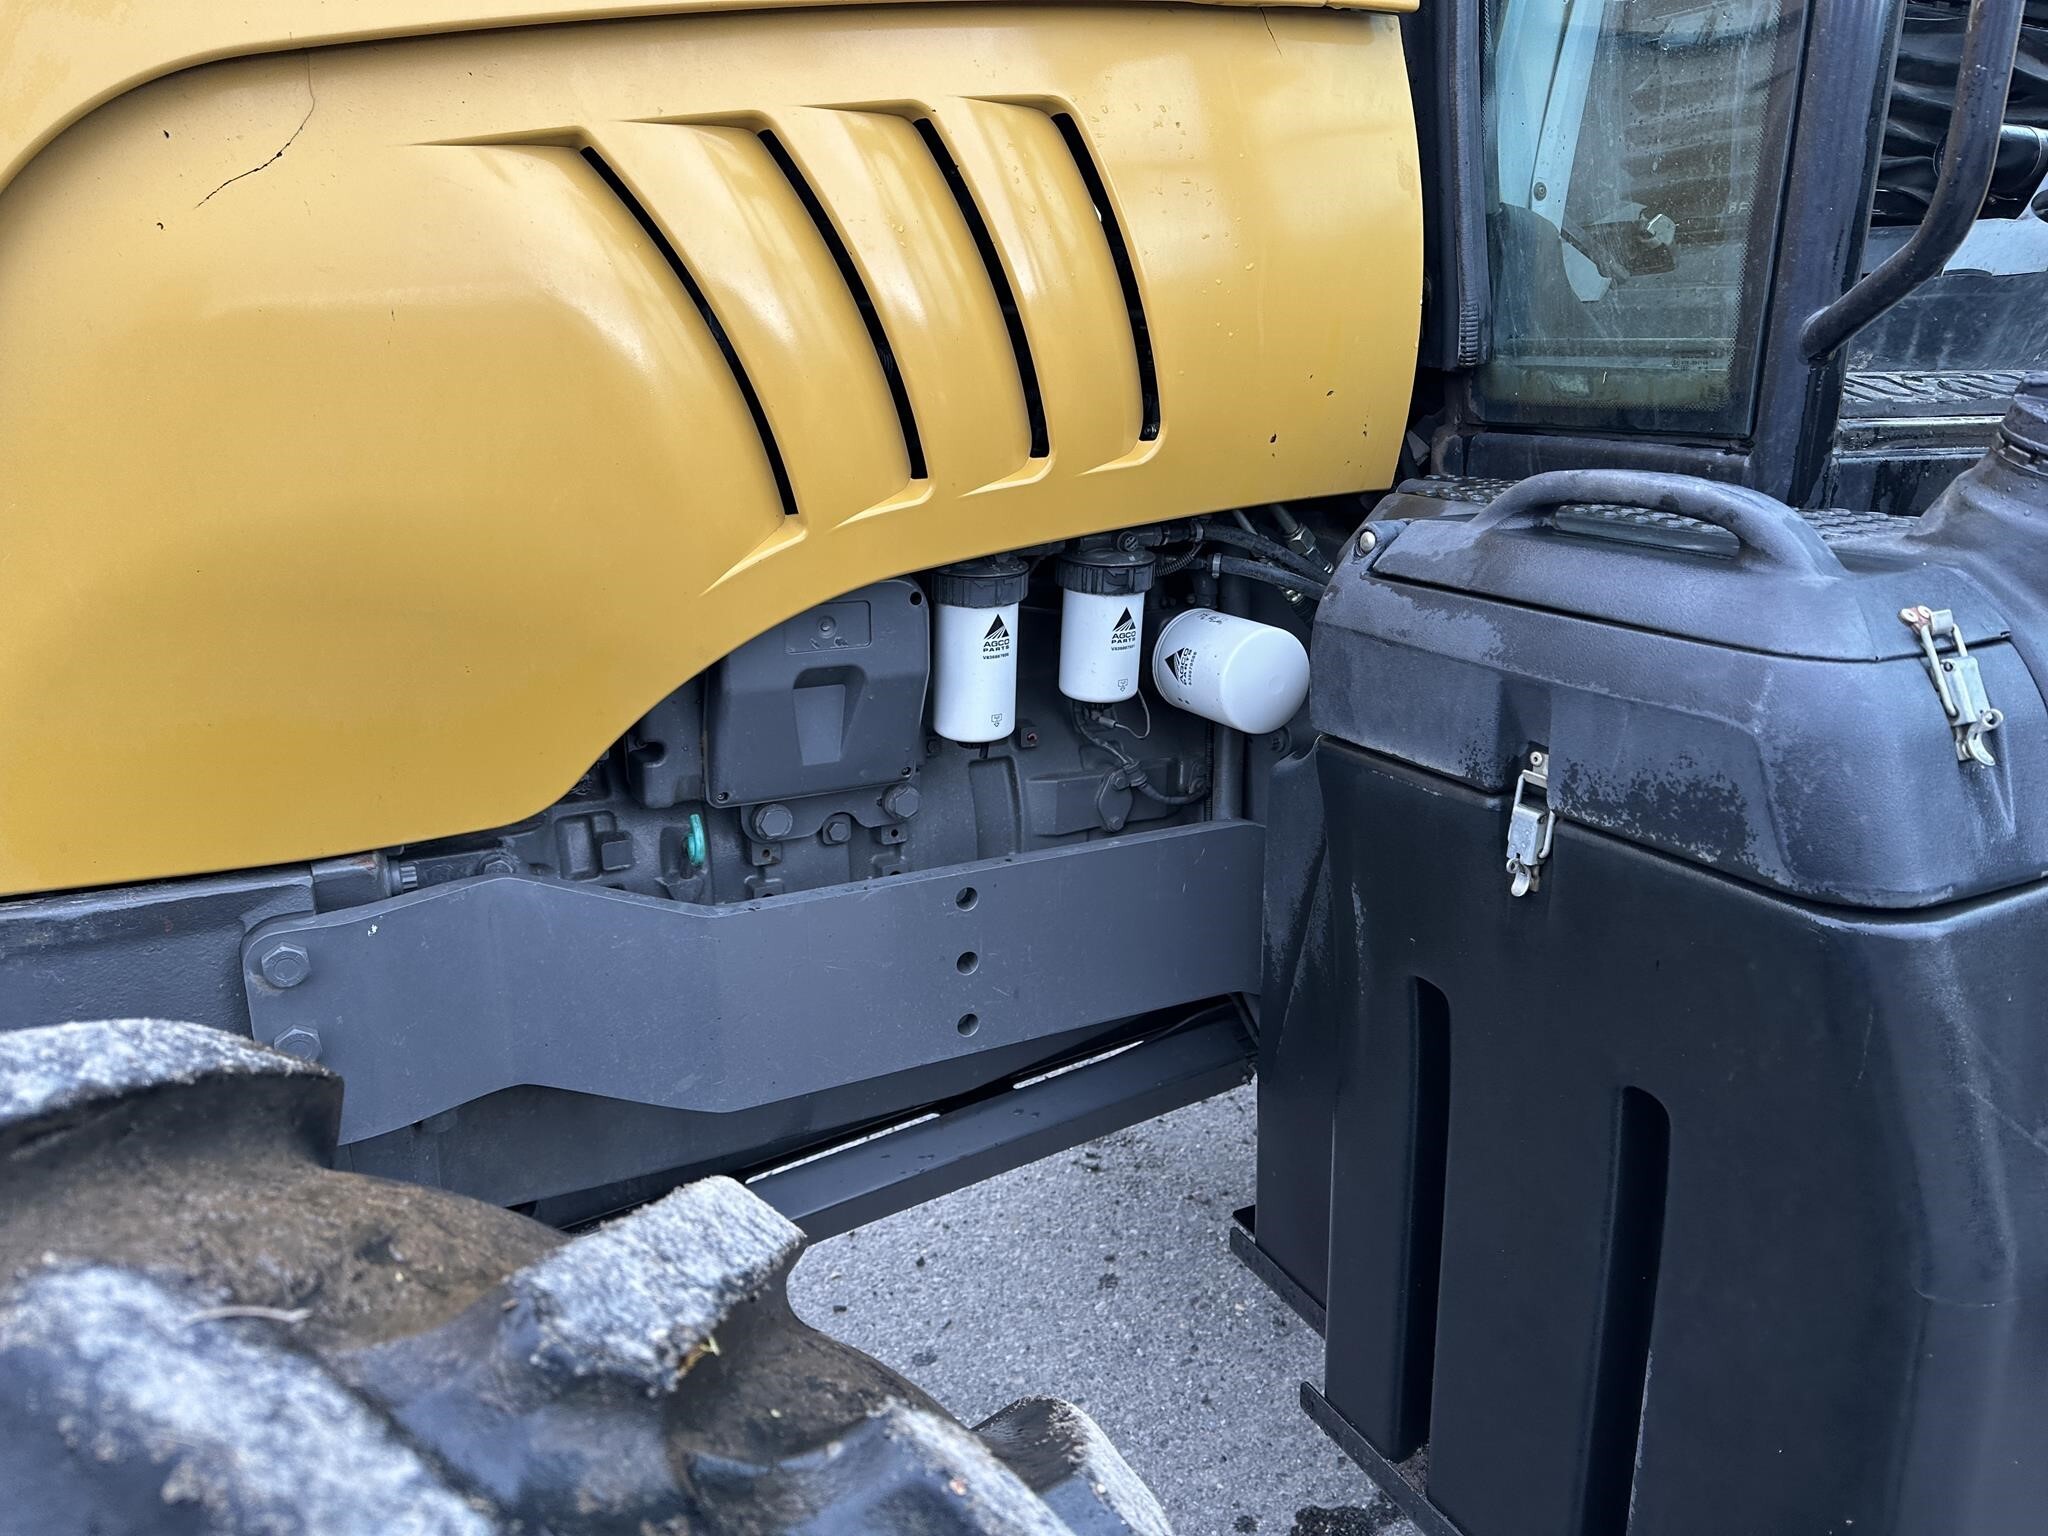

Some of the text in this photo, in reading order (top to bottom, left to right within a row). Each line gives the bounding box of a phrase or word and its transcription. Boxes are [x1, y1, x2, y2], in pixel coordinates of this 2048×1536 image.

[1112, 630, 1136, 640] AGCO
[983, 638, 1010, 648] AGCO
[983, 645, 1010, 653] PARTS
[1180, 648, 1189, 684] AGCO
